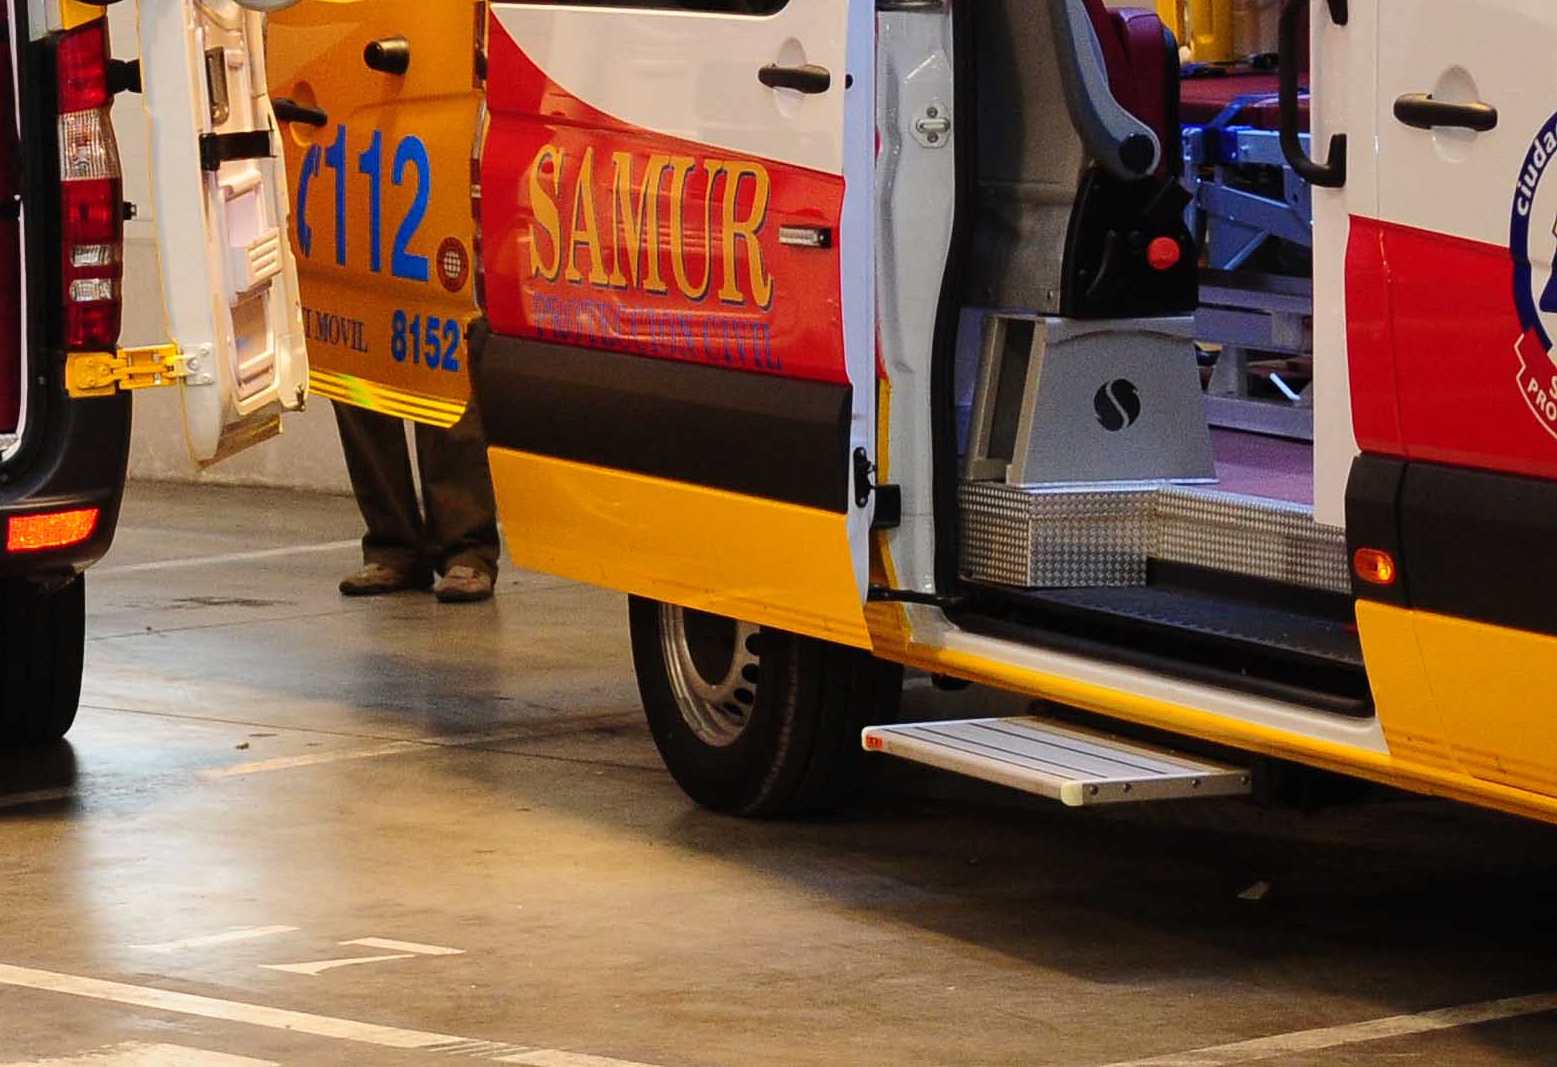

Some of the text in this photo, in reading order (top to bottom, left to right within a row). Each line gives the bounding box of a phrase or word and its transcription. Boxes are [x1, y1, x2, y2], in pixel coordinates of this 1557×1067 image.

[325, 123, 431, 282] 112
[1517, 122, 1557, 216] ciuda
[529, 143, 774, 313] SAMUR
[315, 310, 369, 353] MOVIL
[390, 308, 461, 373] 8152
[532, 290, 782, 370] PROTECCION CIVIL
